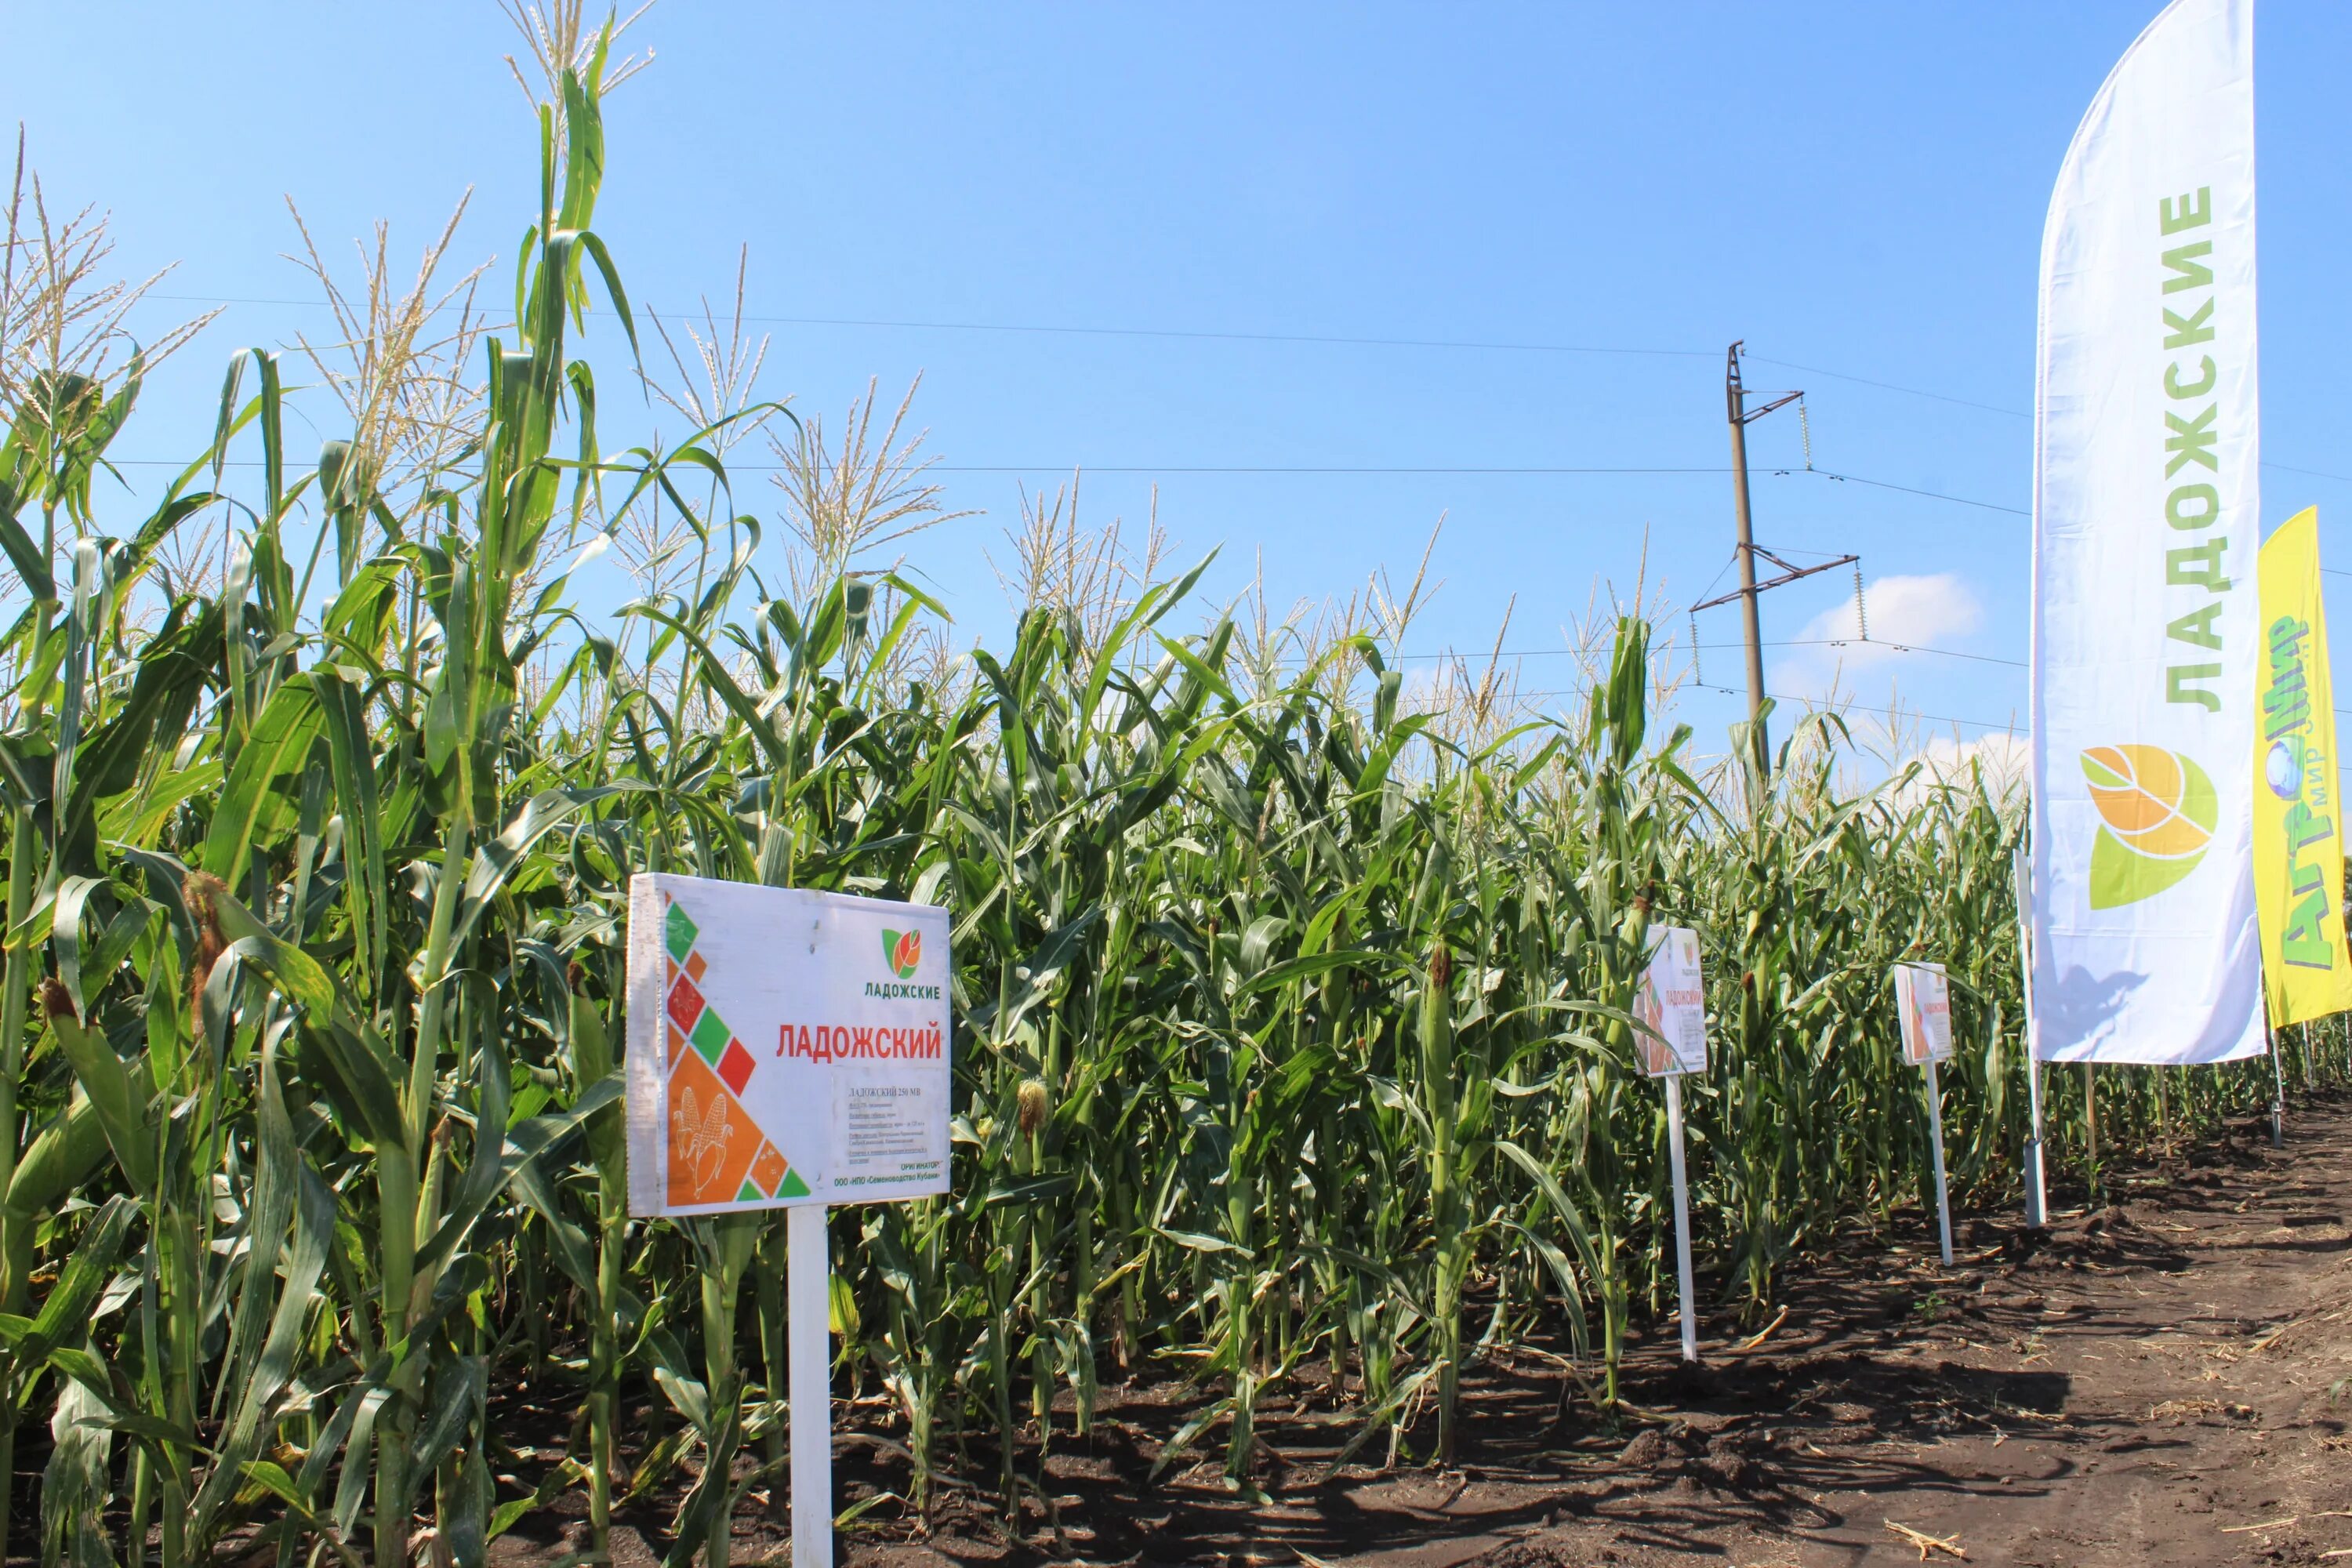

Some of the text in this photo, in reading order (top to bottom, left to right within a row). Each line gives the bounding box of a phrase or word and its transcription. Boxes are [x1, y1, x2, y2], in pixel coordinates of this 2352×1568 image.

[2159, 185, 2232, 713] ЛАДОЖСКИЕ
[2305, 747, 2328, 807] мир
[865, 982, 940, 1000] ЛАДОЖСКИЕ
[776, 1021, 941, 1064] ЛАДОЖСКИЙ
[848, 1086, 897, 1098] ЛАДОЖСКИЙ
[834, 1178, 848, 1186] ООО
